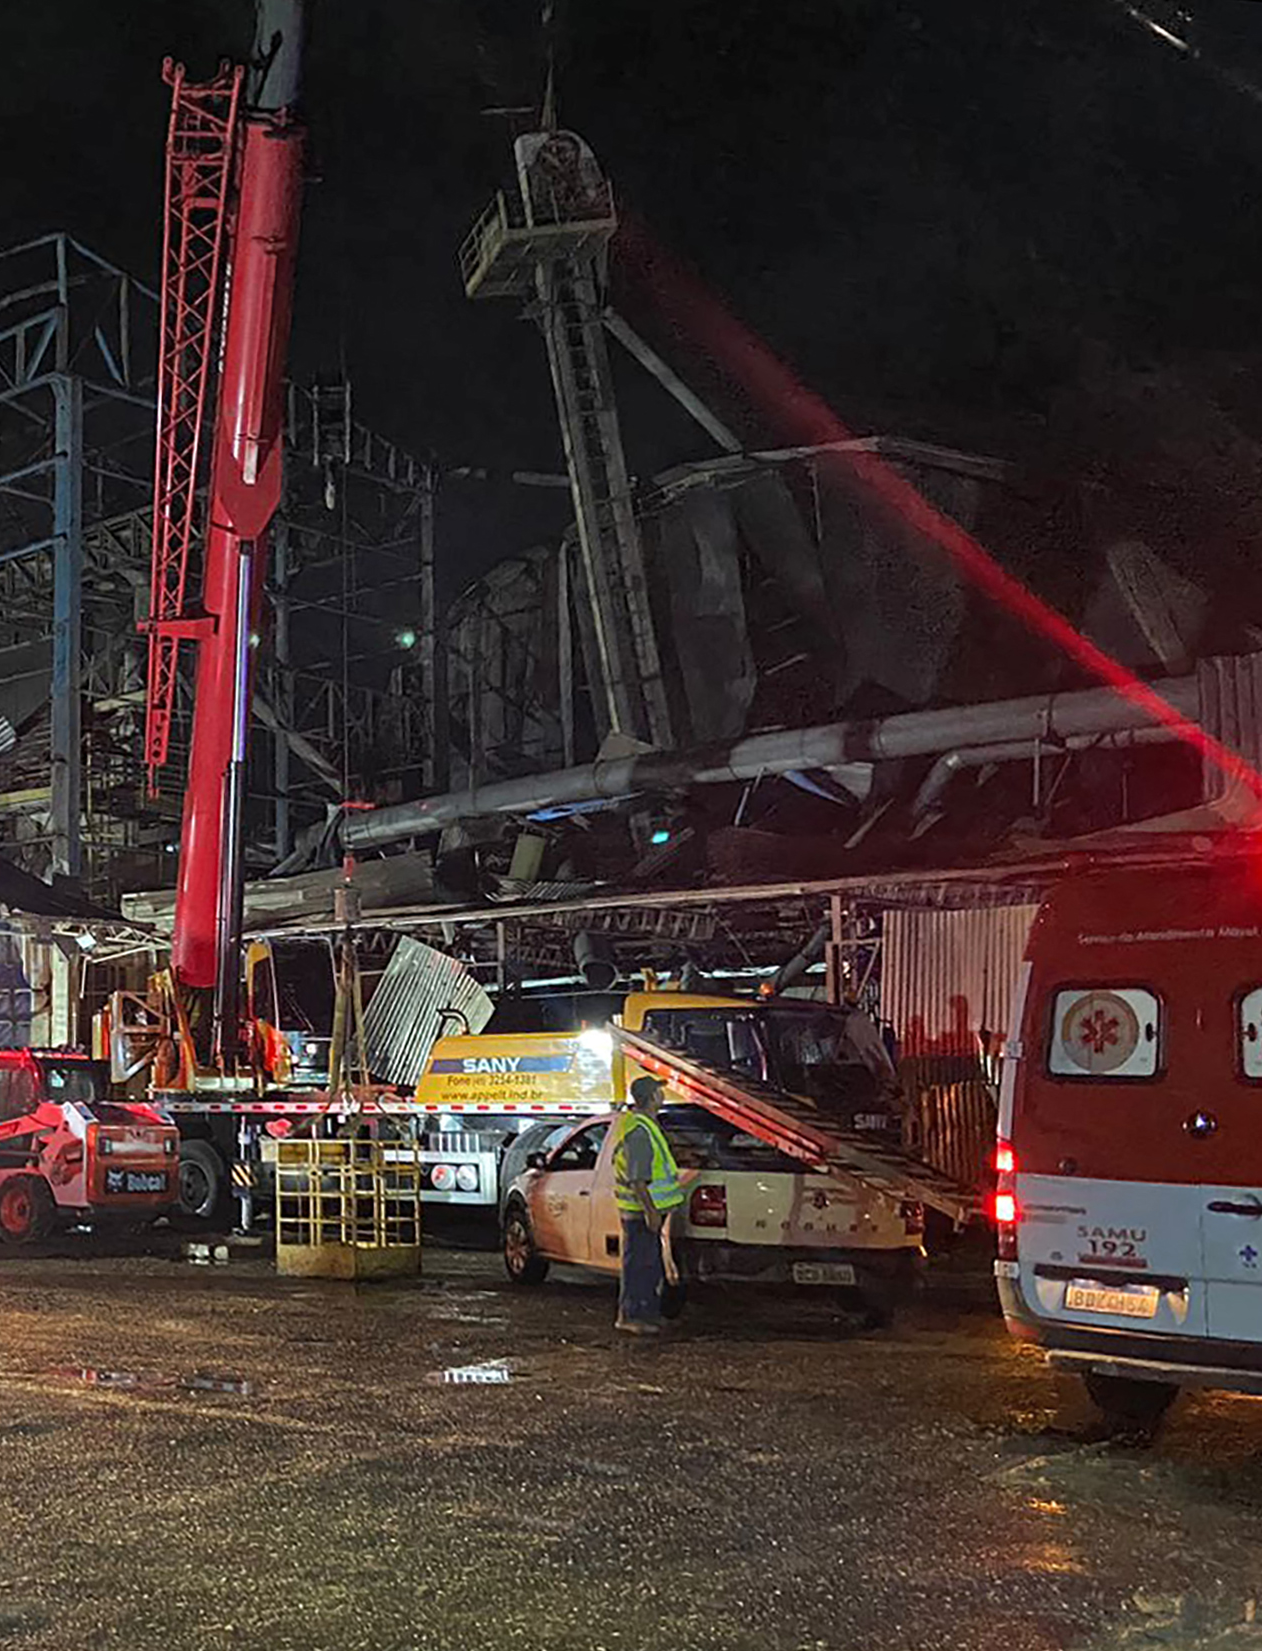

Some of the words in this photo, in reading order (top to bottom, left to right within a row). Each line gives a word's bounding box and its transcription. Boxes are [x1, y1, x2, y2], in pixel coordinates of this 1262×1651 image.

[462, 1057, 521, 1074] SANY
[447, 1075, 471, 1087] Fone
[127, 1172, 167, 1192] Bobcat
[1077, 1225, 1147, 1242] SAMU
[1088, 1239, 1137, 1258] 192
